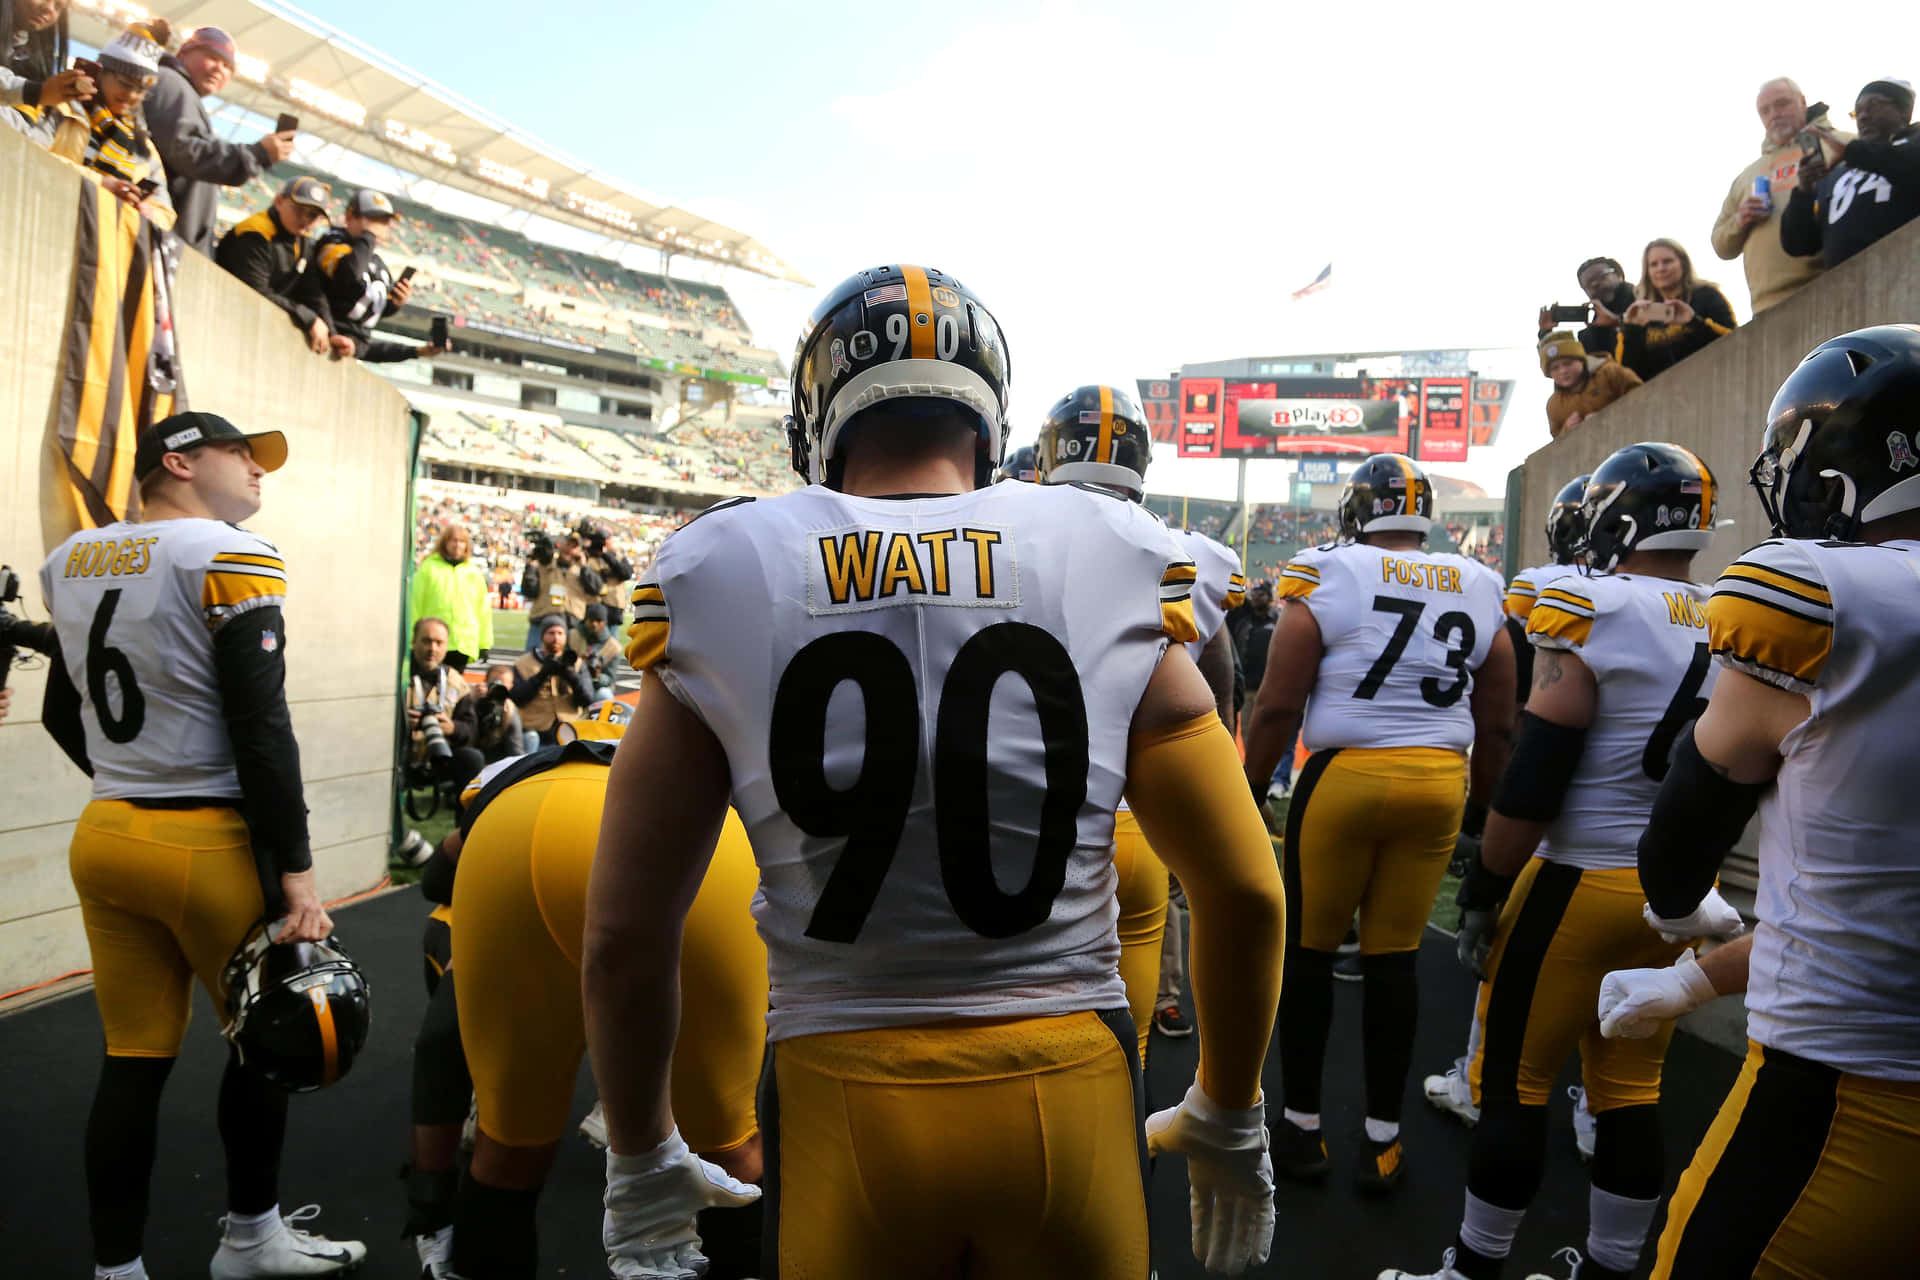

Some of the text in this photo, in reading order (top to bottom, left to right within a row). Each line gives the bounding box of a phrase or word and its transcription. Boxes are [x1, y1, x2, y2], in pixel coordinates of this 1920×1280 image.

[1828, 168, 1893, 225] 84
[885, 313, 960, 361] 90
[1083, 436, 1119, 464] 71
[1298, 471, 1336, 484] LIGHT
[1396, 495, 1424, 516] 73
[1688, 503, 1717, 529] 62
[64, 537, 159, 578] HODGES
[818, 527, 1002, 604] WATT
[1382, 556, 1463, 594] FOSTER
[87, 588, 146, 744] 6
[1352, 594, 1476, 708] 73
[769, 621, 1090, 945] 90
